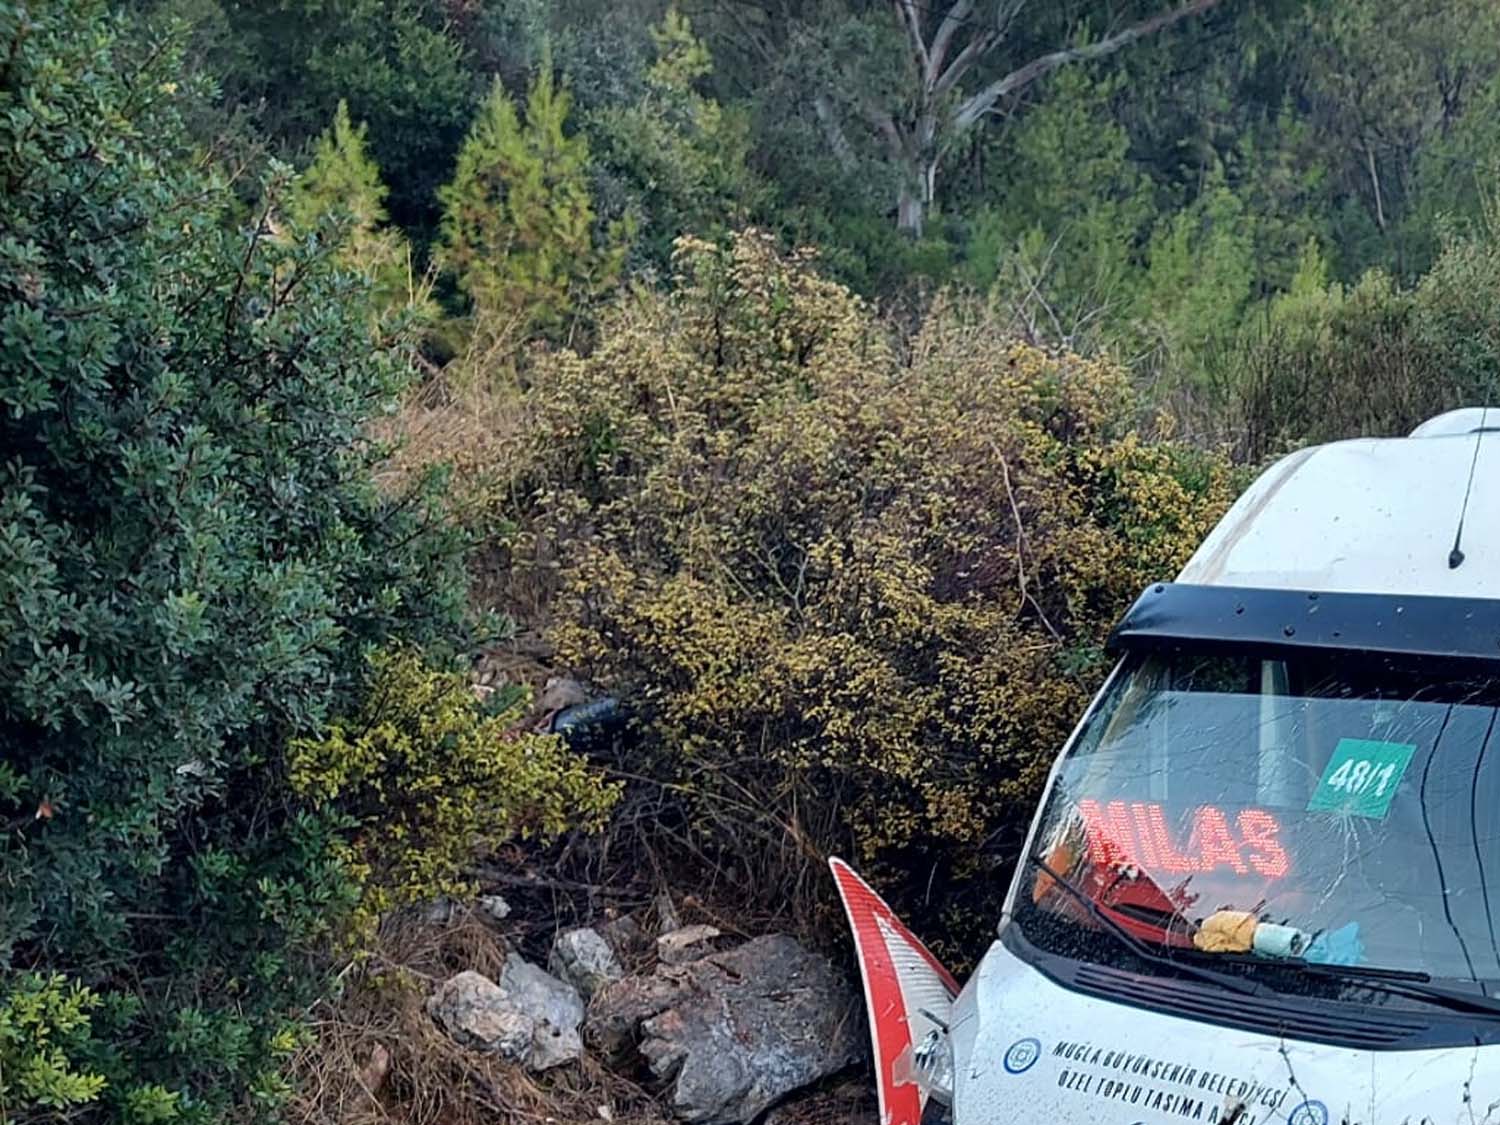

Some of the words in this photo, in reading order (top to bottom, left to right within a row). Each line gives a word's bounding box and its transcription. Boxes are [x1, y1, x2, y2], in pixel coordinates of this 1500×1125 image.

[1327, 758, 1396, 797] 48/1
[1058, 1066, 1093, 1093] ÖZEL
[1095, 1077, 1142, 1104] TOPLU
